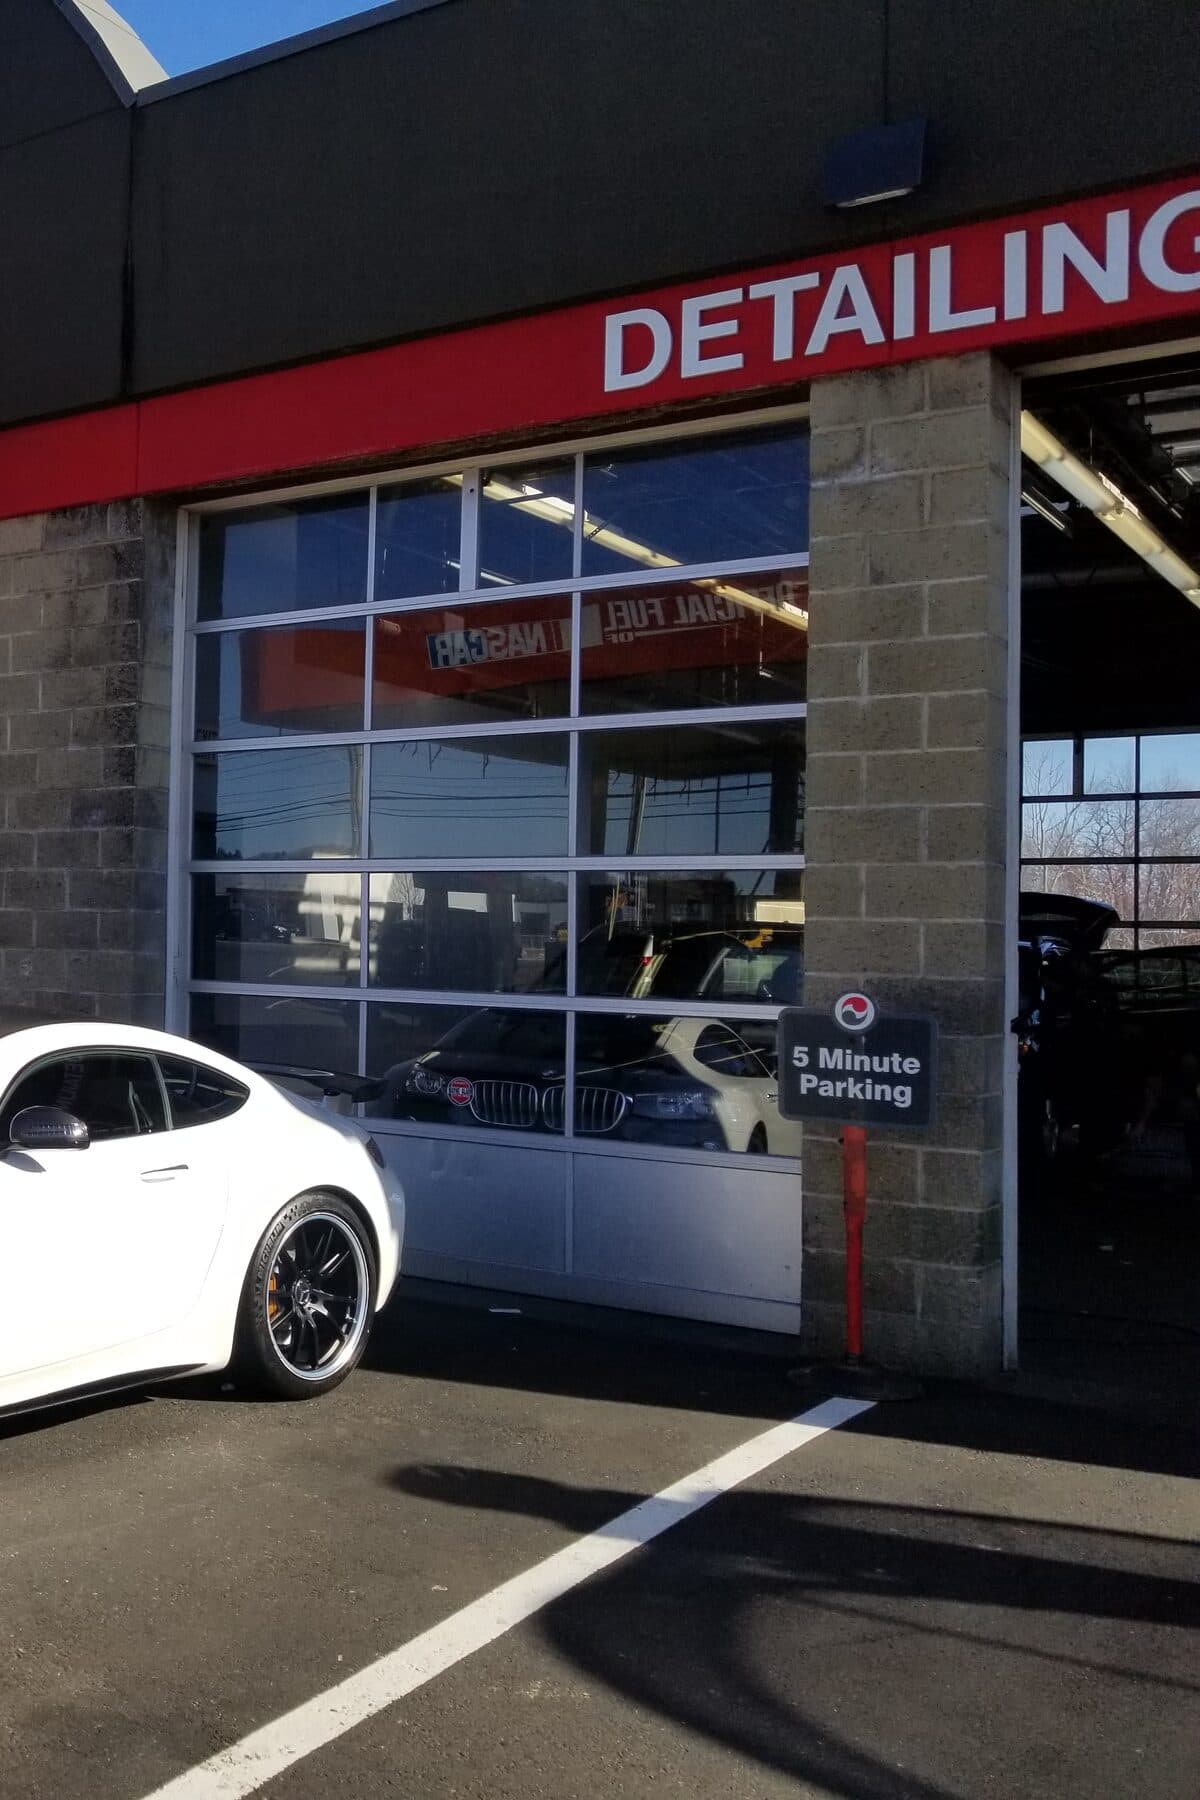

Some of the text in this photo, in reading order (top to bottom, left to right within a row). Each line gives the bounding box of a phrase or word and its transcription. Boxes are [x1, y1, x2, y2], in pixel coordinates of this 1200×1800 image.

[604, 190, 1200, 392] DETAILING
[792, 1046, 921, 1075] 5 Minute
[800, 1074, 912, 1108] Parking
